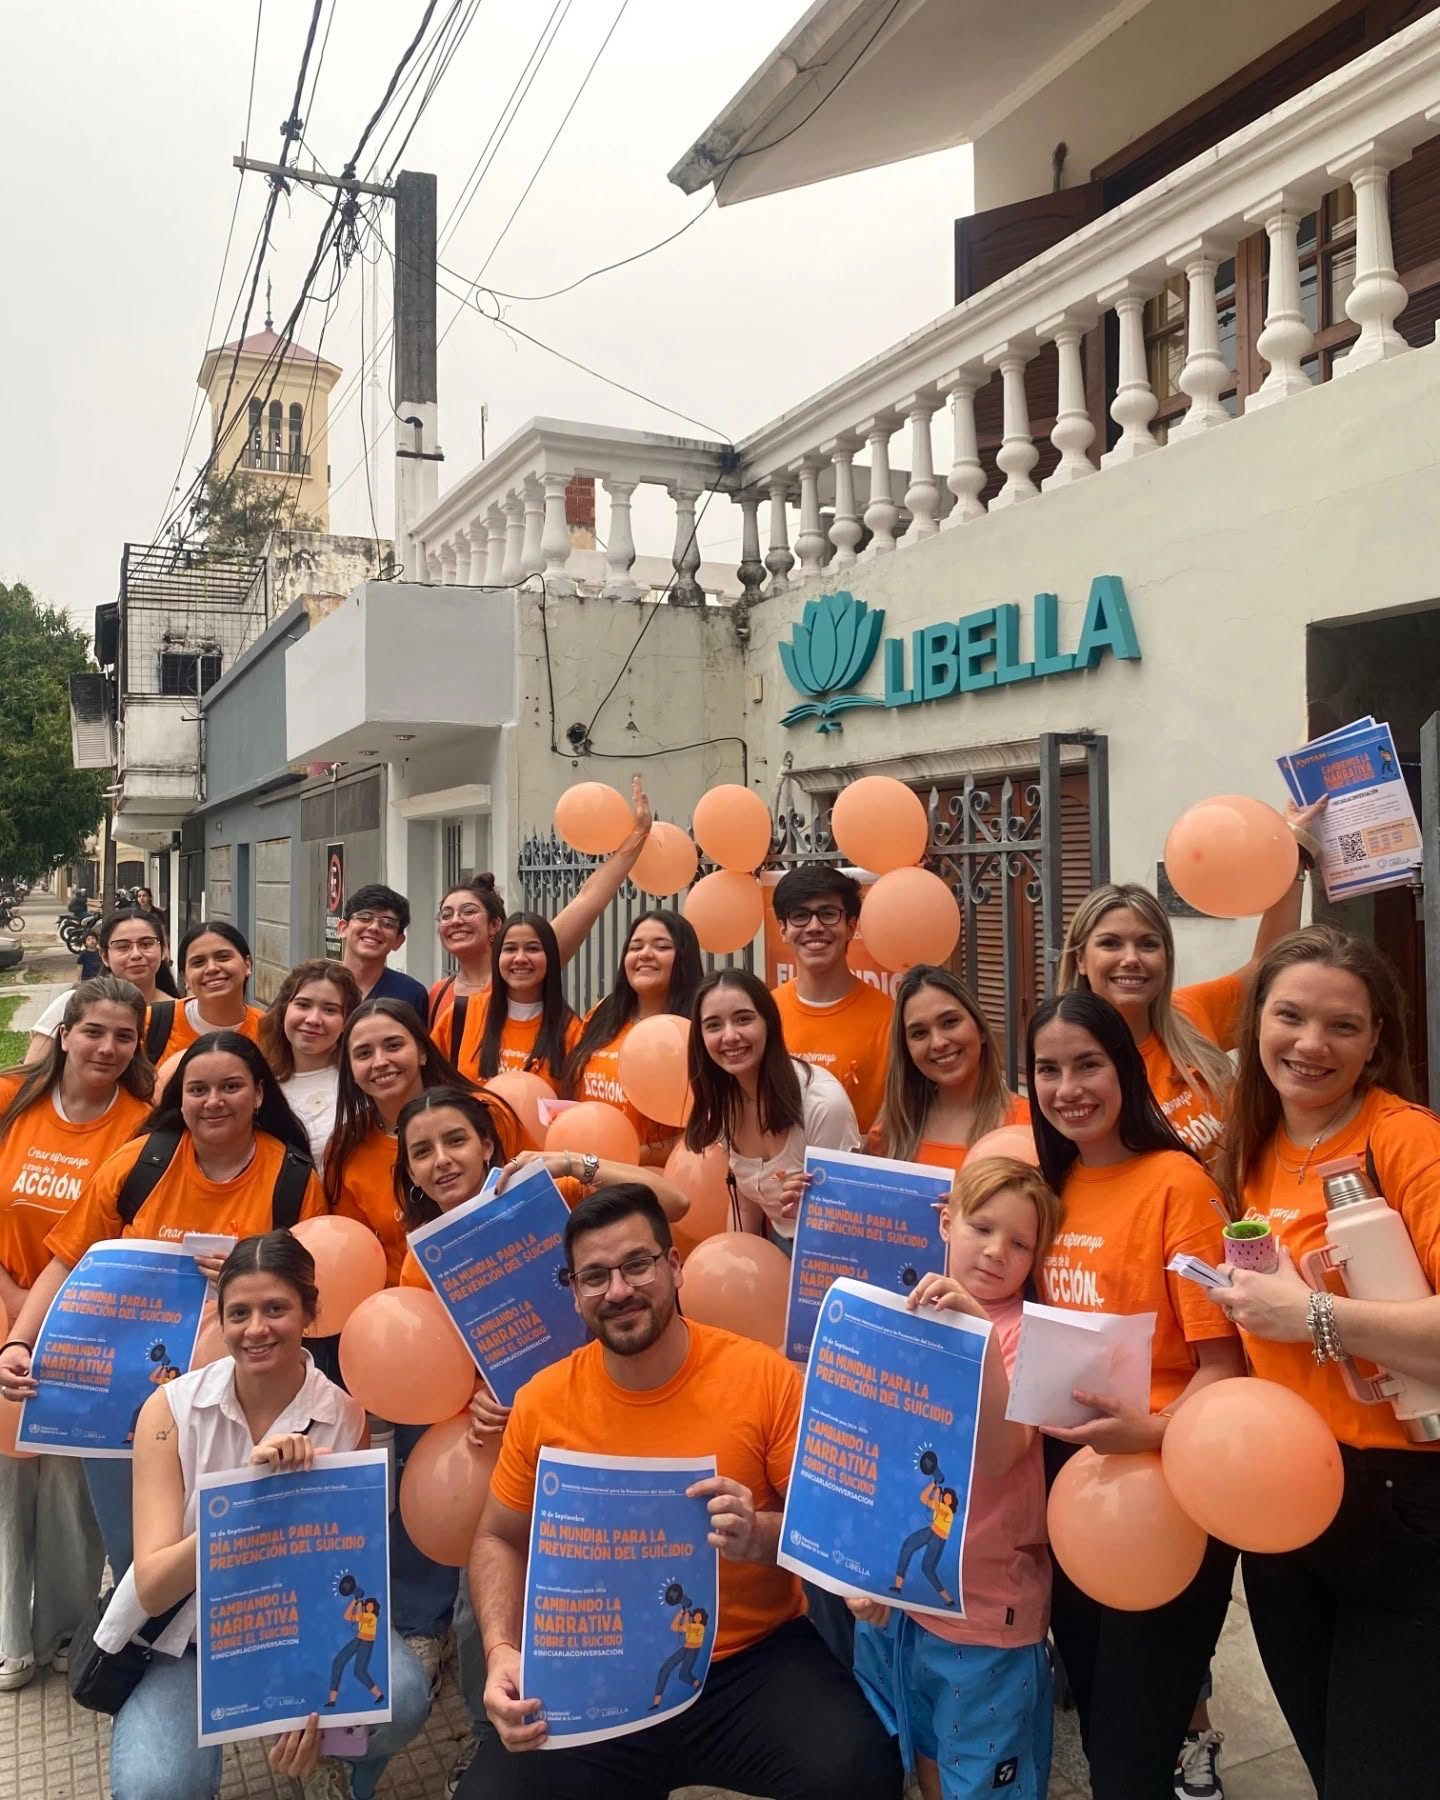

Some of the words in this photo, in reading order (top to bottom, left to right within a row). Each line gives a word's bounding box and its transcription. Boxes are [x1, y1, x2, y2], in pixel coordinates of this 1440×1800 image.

[885, 575, 1142, 708] LIBELLA
[584, 1078, 625, 1103] ACCIÓN
[1176, 1112, 1225, 1152] CIÓN
[27, 1146, 51, 1160] Crear
[12, 1170, 83, 1201] ACCIÓN
[158, 1225, 183, 1239] Crear
[825, 1207, 864, 1225] MUNDIAL
[867, 1214, 893, 1229] PARA
[894, 1219, 908, 1232] LA
[805, 1217, 865, 1238] PREVENCIÓN
[866, 1228, 885, 1241] DEL
[887, 1230, 929, 1249] SUICIDIO
[449, 1266, 506, 1304] PREVENCIÓN
[504, 1257, 523, 1275] DEL
[523, 1232, 562, 1263] SUICIDIO
[459, 1257, 498, 1285] MUNDIAL
[497, 1244, 522, 1263] PARA
[523, 1233, 537, 1249] LA
[801, 1258, 855, 1277] CAMBIANDO
[856, 1266, 869, 1280] LA
[77, 1289, 118, 1306] MUNDIAL
[119, 1294, 148, 1309] PARA
[150, 1297, 163, 1309] LA
[57, 1300, 118, 1318] PREVENCIÓN
[118, 1306, 137, 1320] DEL
[140, 1309, 183, 1324] SUICIDIO
[470, 1307, 519, 1340] CAMBIANDO
[520, 1300, 535, 1314] LA
[475, 1312, 542, 1353] NARRATIVA
[44, 1341, 100, 1358] CAMBIANDO
[102, 1347, 116, 1360] LA
[40, 1356, 114, 1375] NARRATIVA
[819, 1346, 835, 1365] DÍA
[835, 1355, 878, 1384] MUNDIAL
[880, 1371, 911, 1392] PARA
[914, 1382, 929, 1399] LA
[816, 1364, 878, 1401] PREVENCIÓN
[879, 1390, 900, 1408] DEL
[903, 1397, 954, 1425] SUICIDIO
[808, 1418, 864, 1451] CAMBIANDO
[865, 1441, 880, 1459] LA
[804, 1434, 878, 1481] NARRATIVA
[802, 1455, 827, 1475] SOBRE
[827, 1465, 838, 1480] EL
[839, 1470, 876, 1496] SUICIDIO
[554, 1512, 585, 1522] Septiembre
[209, 1535, 230, 1556] DÍA
[233, 1527, 285, 1550] MUNDIAL
[288, 1523, 321, 1539] PARA
[324, 1522, 340, 1536] LA
[226, 1524, 261, 1538] Septiembre
[539, 1519, 557, 1537] DÍA
[559, 1526, 610, 1543] MUNDIAL
[613, 1529, 648, 1543] PARA
[650, 1528, 666, 1542] LA
[209, 1543, 288, 1571] PREVENCIÓN
[290, 1540, 312, 1554] DEL
[316, 1535, 366, 1551] SUICIDIO
[538, 1540, 611, 1561] PREVENCIÓN
[614, 1547, 637, 1560] DEL
[641, 1543, 694, 1559] SUICIDIO
[845, 1560, 871, 1577] LIBELLA
[210, 1594, 280, 1619] CAMBIANDO
[283, 1590, 298, 1603] LA
[534, 1595, 601, 1613] CAMBIANDO
[606, 1597, 621, 1611] LA
[210, 1606, 299, 1638] NARRATIVA
[534, 1613, 623, 1633] NARRATIVA
[210, 1635, 242, 1652] SOBRE
[244, 1632, 257, 1644] EL
[258, 1624, 299, 1640] SUICIDIO
[533, 1634, 565, 1648] SOBRE
[567, 1635, 579, 1648] EL
[582, 1634, 623, 1647] SUICIDIO
[278, 1698, 306, 1706] LIBELLA
[602, 1708, 629, 1717] LIBELLA
